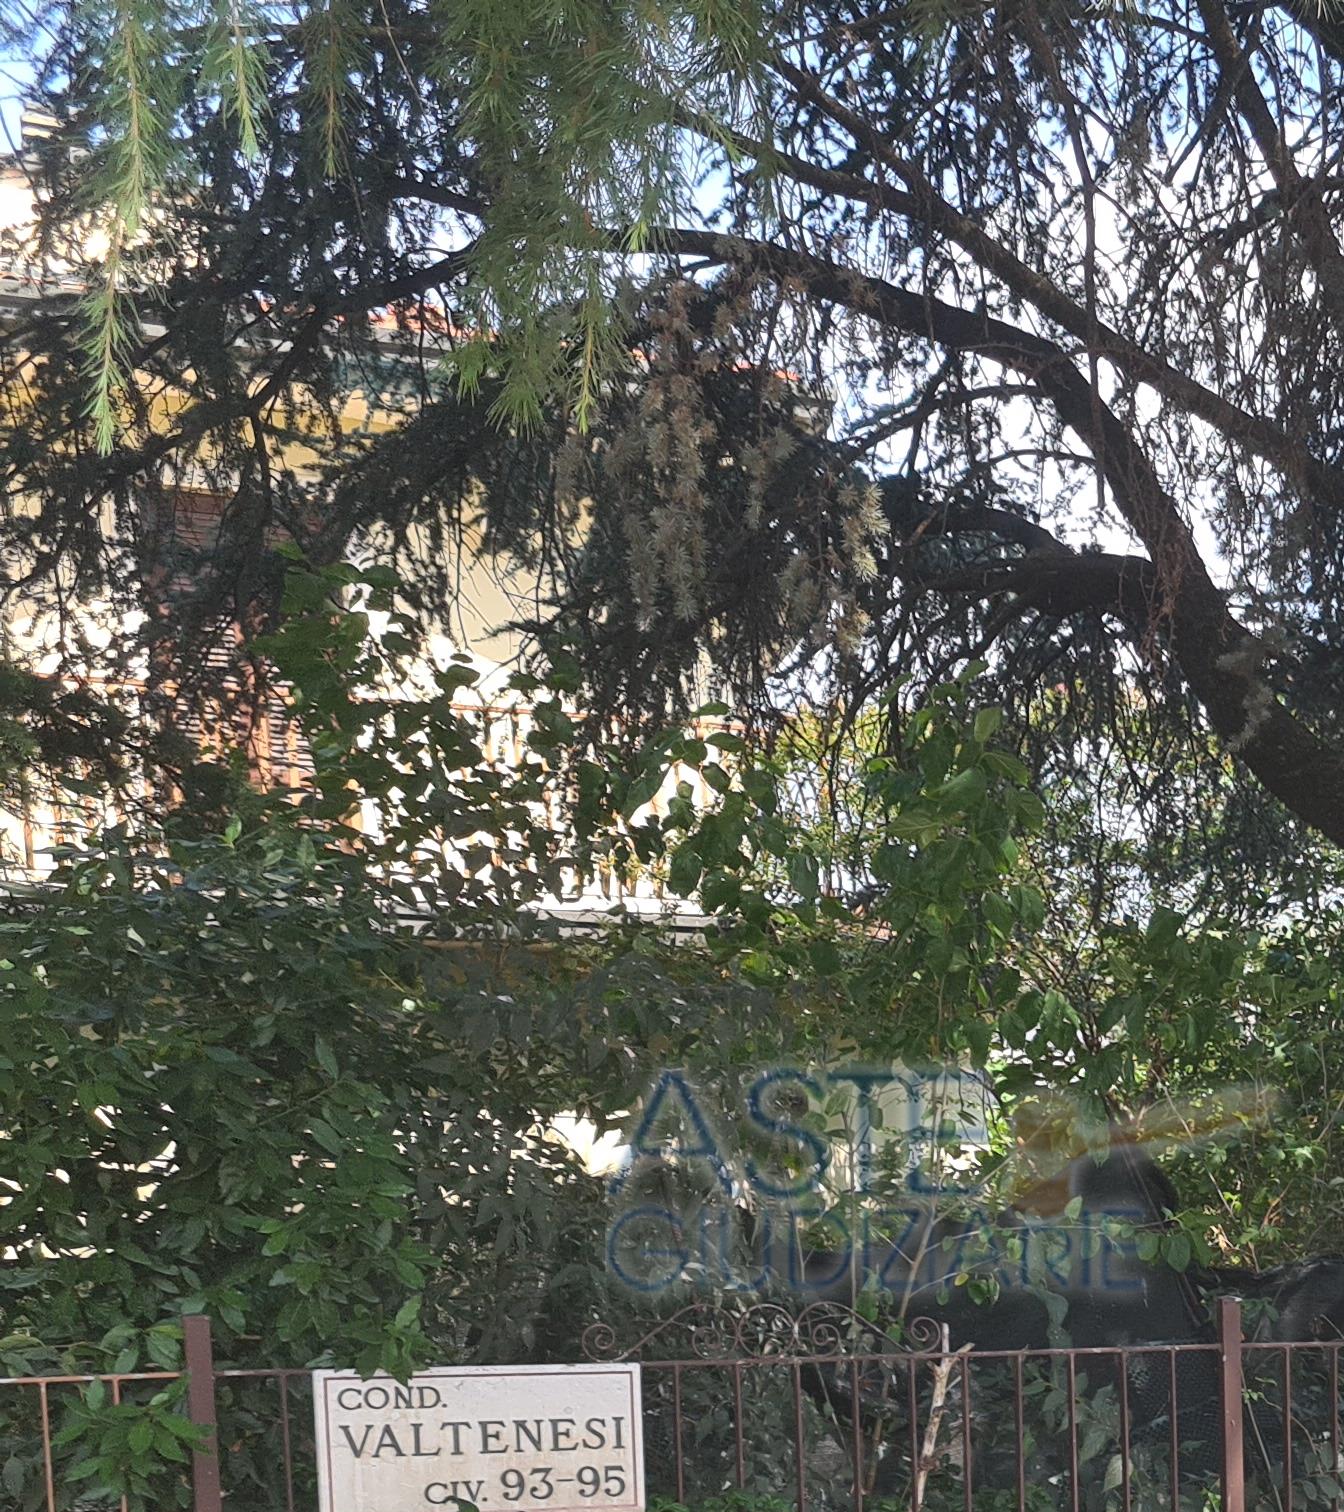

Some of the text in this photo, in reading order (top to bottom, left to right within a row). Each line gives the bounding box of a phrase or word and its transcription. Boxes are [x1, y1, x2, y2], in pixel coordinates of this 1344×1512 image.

[337, 1385, 448, 1411] COND.
[339, 1416, 626, 1458] VALTENESI
[423, 1466, 627, 1505] CIV. 93-95
